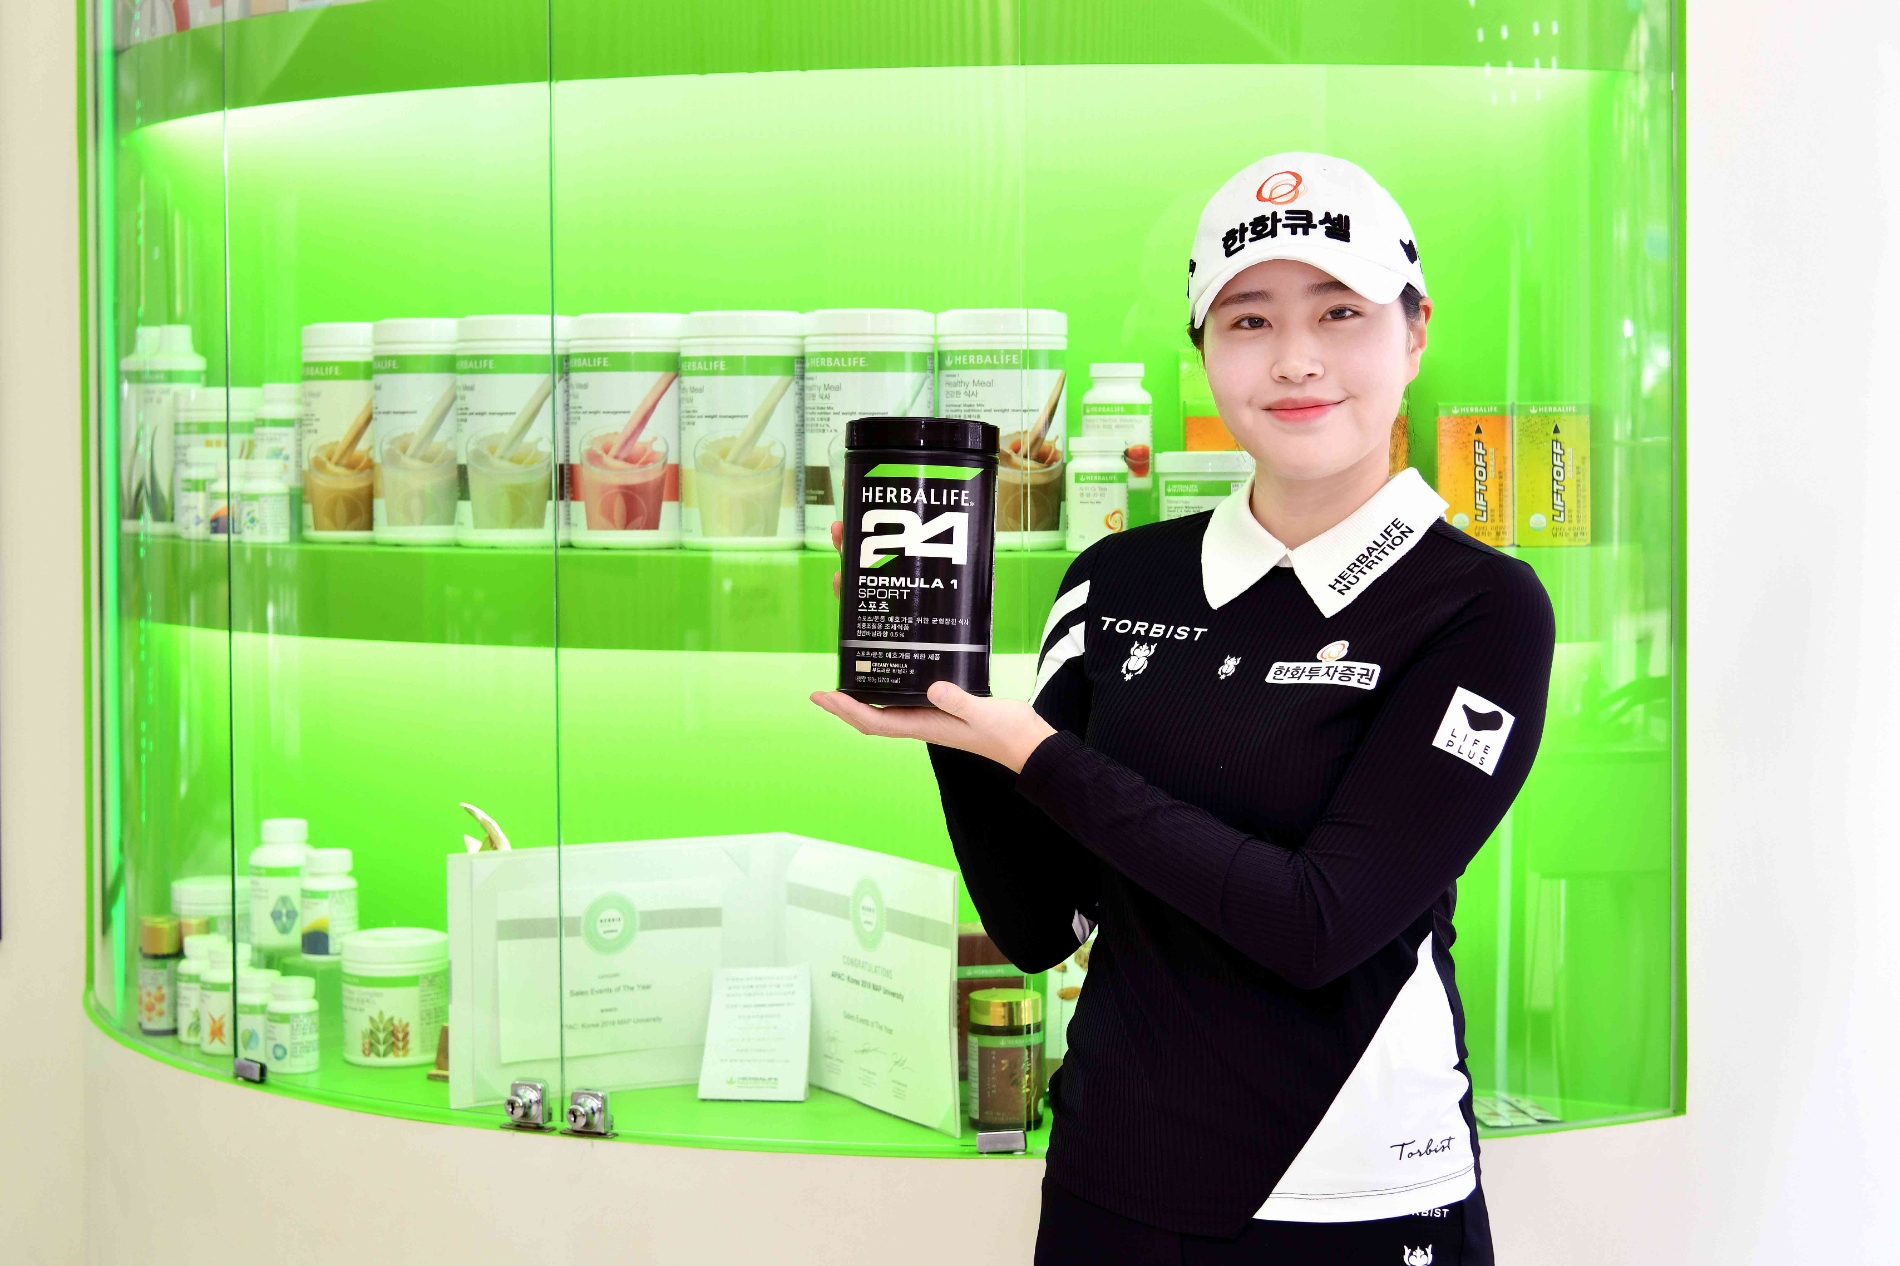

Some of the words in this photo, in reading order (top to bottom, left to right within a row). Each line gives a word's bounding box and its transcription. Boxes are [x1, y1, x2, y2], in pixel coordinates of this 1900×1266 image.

[1222, 210, 1350, 258] 한화큐셀
[810, 357, 866, 367] HERBALIFE
[955, 354, 1018, 365] HERBALIFE
[823, 383, 842, 392] Meal
[945, 380, 970, 390] Healthy
[973, 379, 994, 387] Meal
[963, 390, 978, 398] 식사
[1474, 439, 1488, 523] LIFTOFF
[1552, 439, 1565, 523] LIFTOFF
[862, 486, 970, 506] HERBALIFE
[859, 509, 969, 569] 24
[1328, 517, 1404, 590] HERBALIFE
[1336, 525, 1415, 596] NUTRITION
[858, 576, 944, 589] FORMULA
[950, 579, 958, 589] 1
[858, 588, 911, 600] SPORT
[858, 601, 889, 612] 스포츠
[884, 623, 910, 631] 조제식품
[888, 616, 913, 624] 애호가를
[1101, 616, 1208, 641] TORBIST
[886, 652, 911, 660] 애호가를
[1272, 665, 1376, 686] 한화투자증권
[1450, 728, 1491, 755] LIFE
[1445, 739, 1485, 766] PLUS
[843, 955, 893, 979] CONGRATULATIONS
[570, 989, 588, 997] Sales
[590, 987, 612, 996] Events
[622, 984, 635, 992] The
[637, 983, 653, 991] Year
[883, 986, 904, 1003] University
[633, 1016, 663, 1024] University
[1390, 1136, 1456, 1160] Torbist
